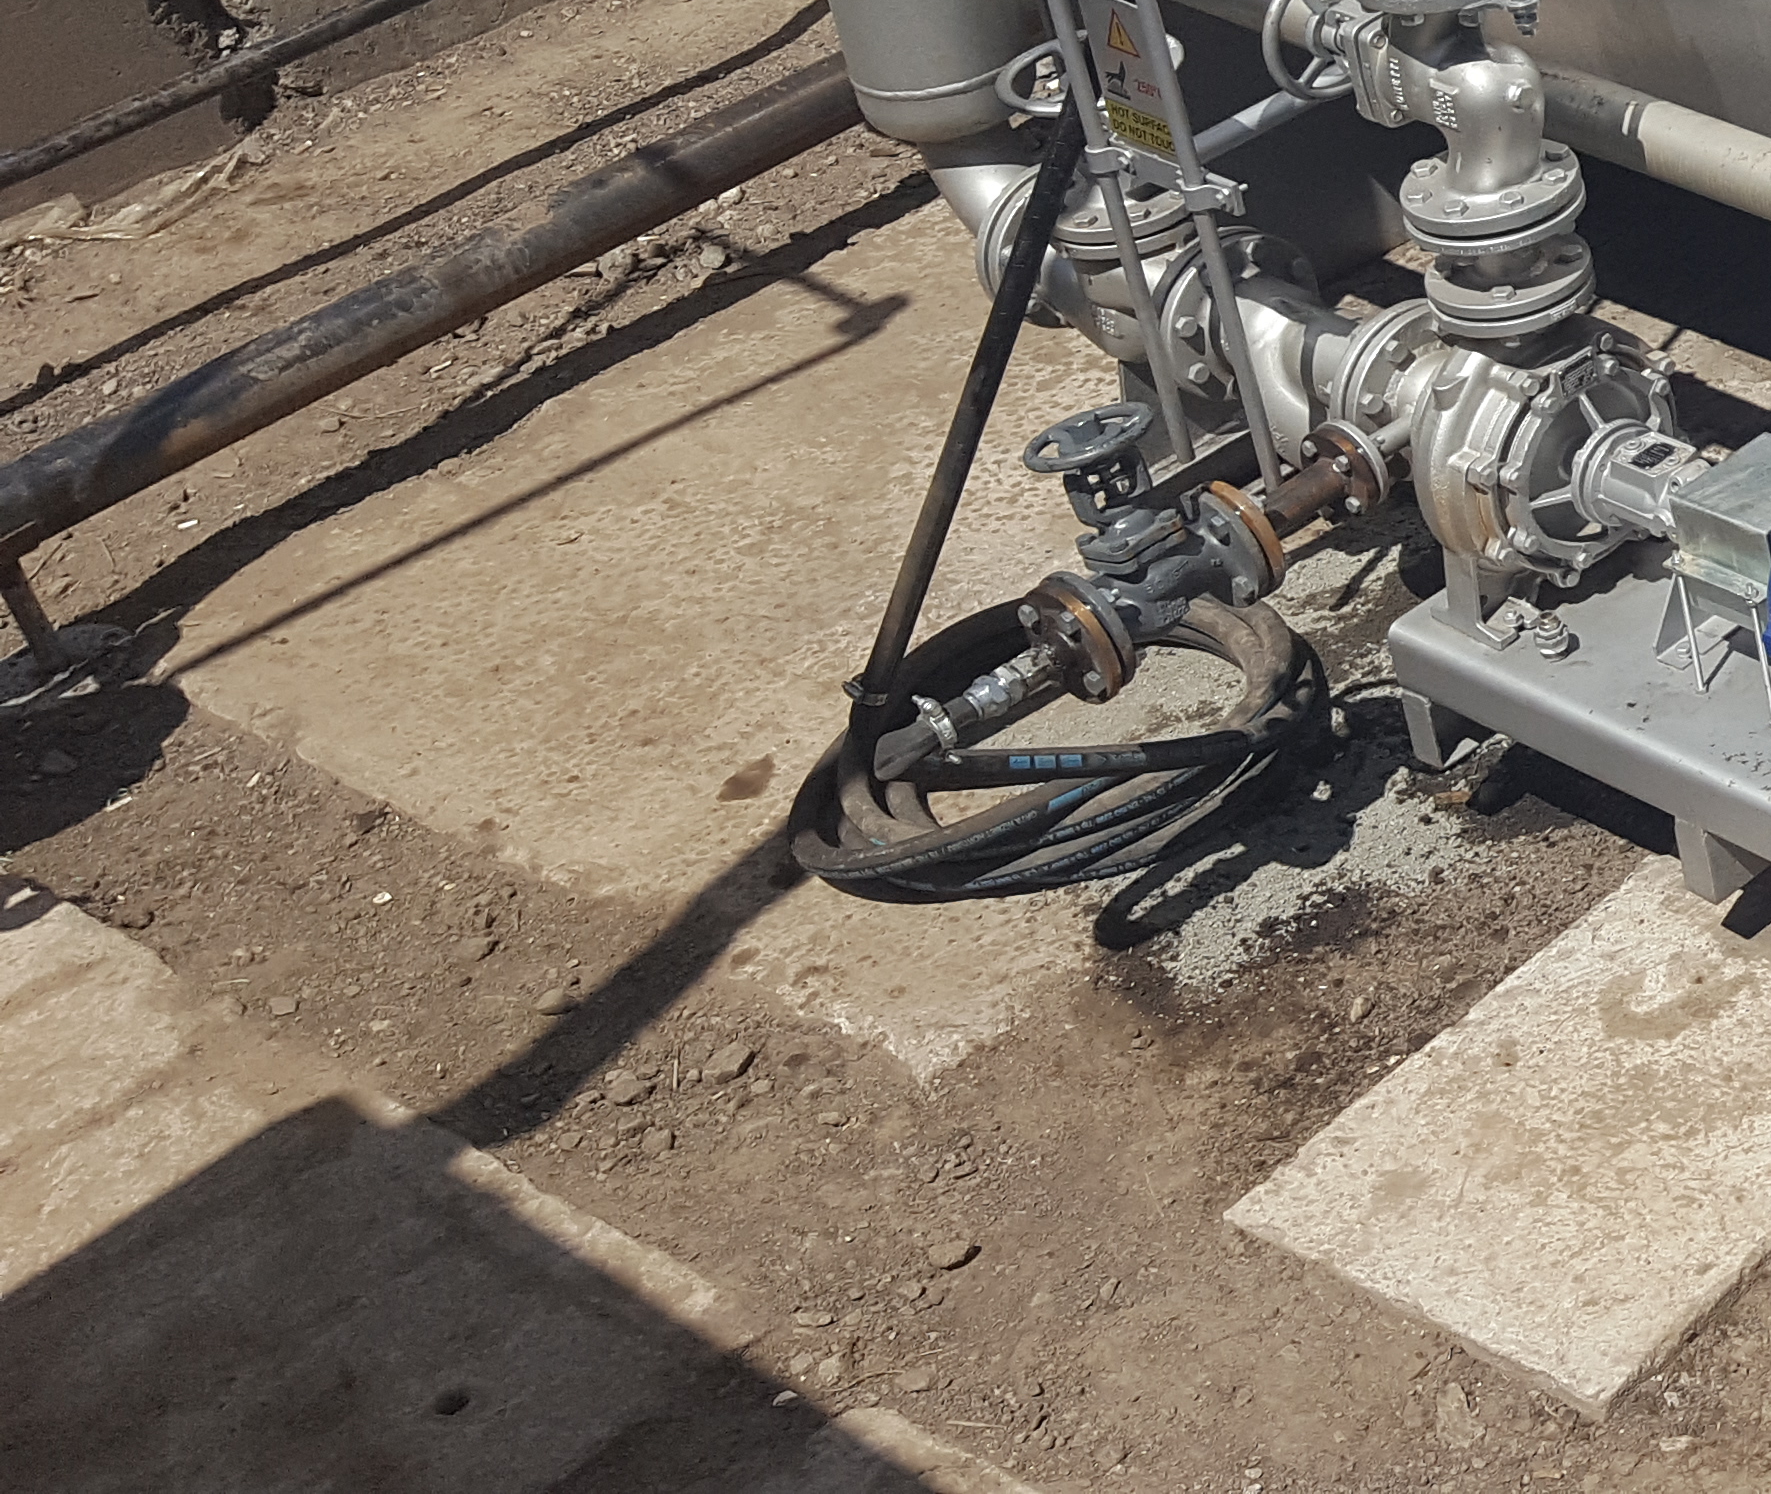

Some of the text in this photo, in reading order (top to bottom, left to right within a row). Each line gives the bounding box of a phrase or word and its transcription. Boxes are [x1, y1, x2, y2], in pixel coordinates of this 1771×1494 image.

[1111, 104, 1172, 137] HOT SURFAC
[1113, 118, 1176, 152] DO NOT TOUC
